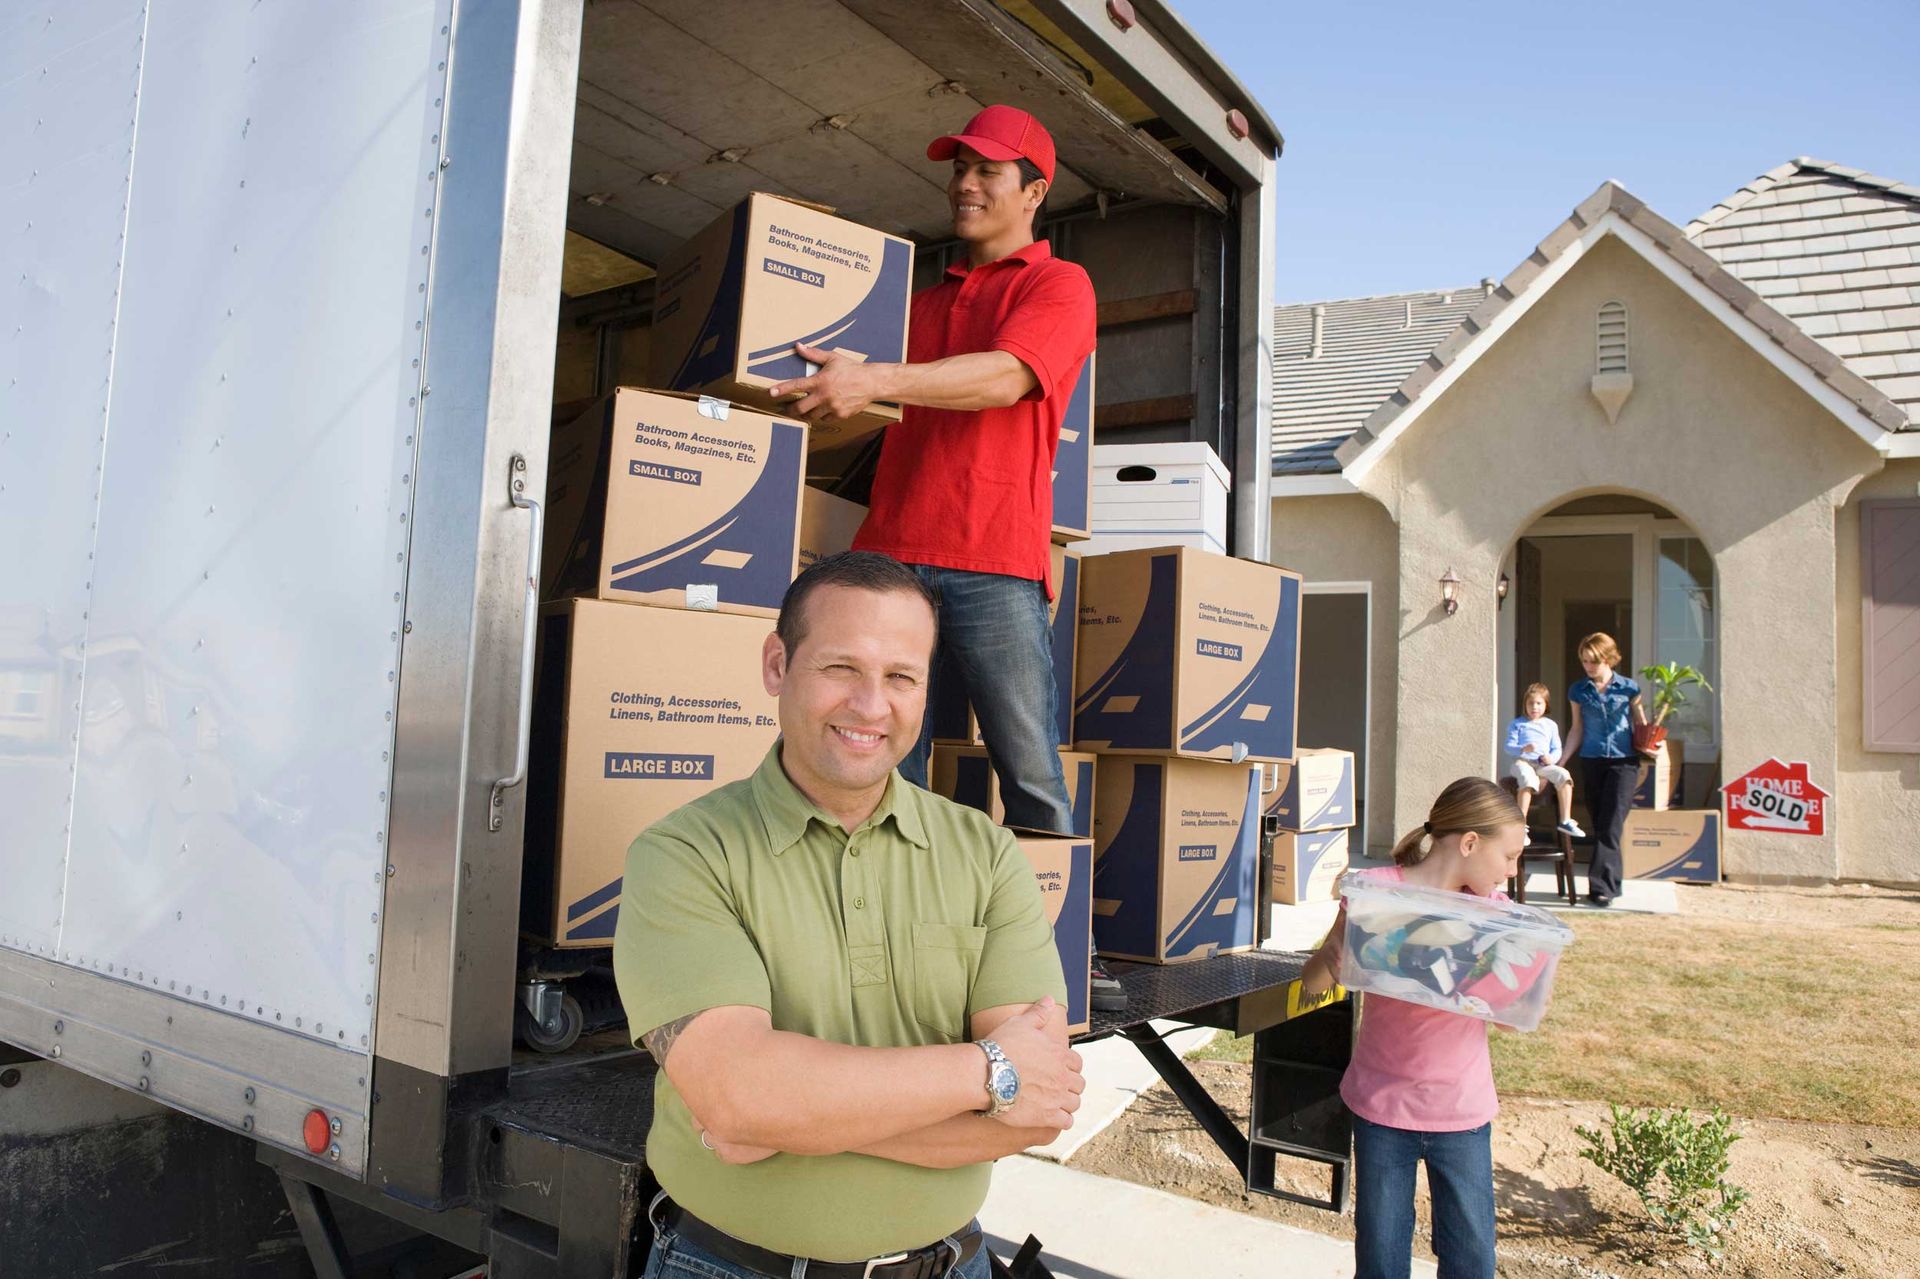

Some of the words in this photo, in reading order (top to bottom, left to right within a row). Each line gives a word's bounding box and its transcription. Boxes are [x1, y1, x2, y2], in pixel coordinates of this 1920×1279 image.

[769, 224, 814, 244] Bathroom
[815, 239, 872, 263] Accessories,
[768, 235, 799, 252] Books,
[801, 245, 852, 268] Magazines,
[854, 260, 871, 273] Etc.
[767, 262, 799, 279] SMALL
[801, 272, 822, 285] BOX
[636, 422, 688, 440] Bathroom
[690, 432, 756, 453] Accessories,
[635, 434, 671, 450] Books,
[674, 442, 733, 461] Magazines,
[736, 453, 756, 464] Etc.
[633, 464, 671, 479] SMALL
[674, 470, 699, 483] BOX
[1106, 615, 1122, 624] Etc.
[1199, 602, 1222, 614] Clothing,
[1223, 607, 1255, 620] Accessories,
[1199, 612, 1217, 622] Linens,
[1219, 616, 1243, 627] Bathroom
[1243, 621, 1259, 631] Items,
[1260, 623, 1270, 632] Etc.
[1199, 642, 1222, 655] LARGE
[1223, 646, 1239, 658] BOX
[610, 691, 665, 708] Clothing,
[667, 695, 742, 712] Accessories,
[609, 708, 654, 723] Linens,
[657, 711, 714, 724] Bathroom
[716, 714, 752, 727] Items,
[755, 715, 777, 727] Etc.
[610, 758, 666, 774] LARGE
[671, 760, 705, 775] BOX
[1748, 789, 1804, 822] SOLD
[1180, 848, 1201, 858] LARGE
[1201, 848, 1214, 857] BOX
[1048, 882, 1062, 891] Etc.
